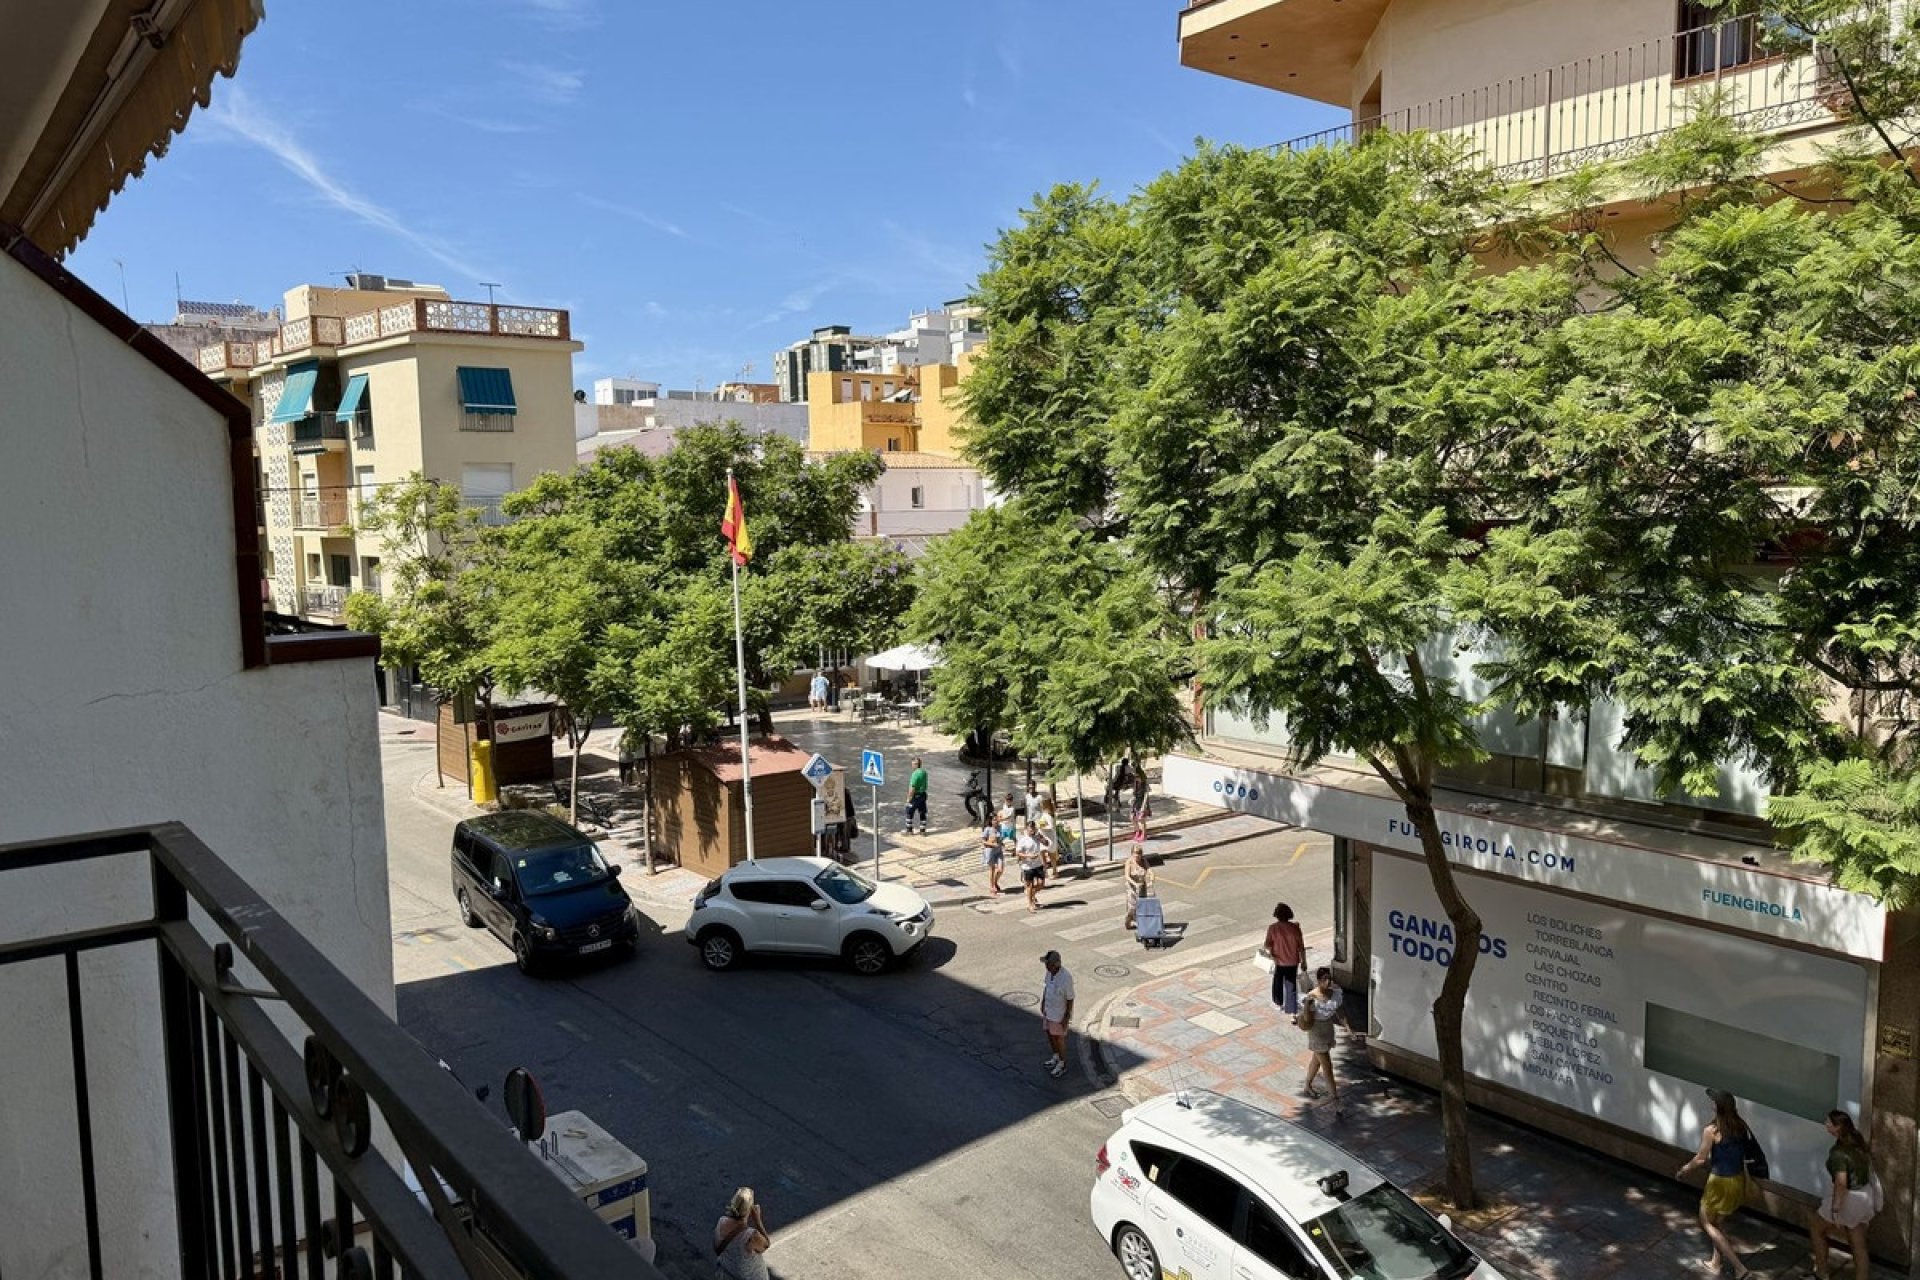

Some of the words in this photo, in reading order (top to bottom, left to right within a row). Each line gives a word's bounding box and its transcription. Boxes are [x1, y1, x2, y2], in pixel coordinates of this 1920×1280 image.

[1389, 819, 1575, 873] FUEGIROLA.COM
[1527, 912, 1548, 927] LOS
[1702, 889, 1803, 921] FUENGIROLA
[1388, 910, 1508, 960] GANAOS
[1536, 929, 1614, 958] TORREBLANCA
[1388, 932, 1454, 968] TODO
[1525, 943, 1581, 966] CARVAJAL
[1525, 972, 1569, 993] CENTRO
[1533, 961, 1555, 975] LAS
[1556, 966, 1602, 988] CHOZAS
[1533, 990, 1579, 1011] RECINTO
[1580, 1003, 1619, 1024] FERIAL
[1525, 1032, 1564, 1053] PUEBLO
[1532, 1020, 1598, 1049] BOQUETILLO
[1522, 1062, 1574, 1087] MIRAMAR
[1532, 1050, 1554, 1065] SAN
[1556, 1058, 1614, 1085] CAYETANO
